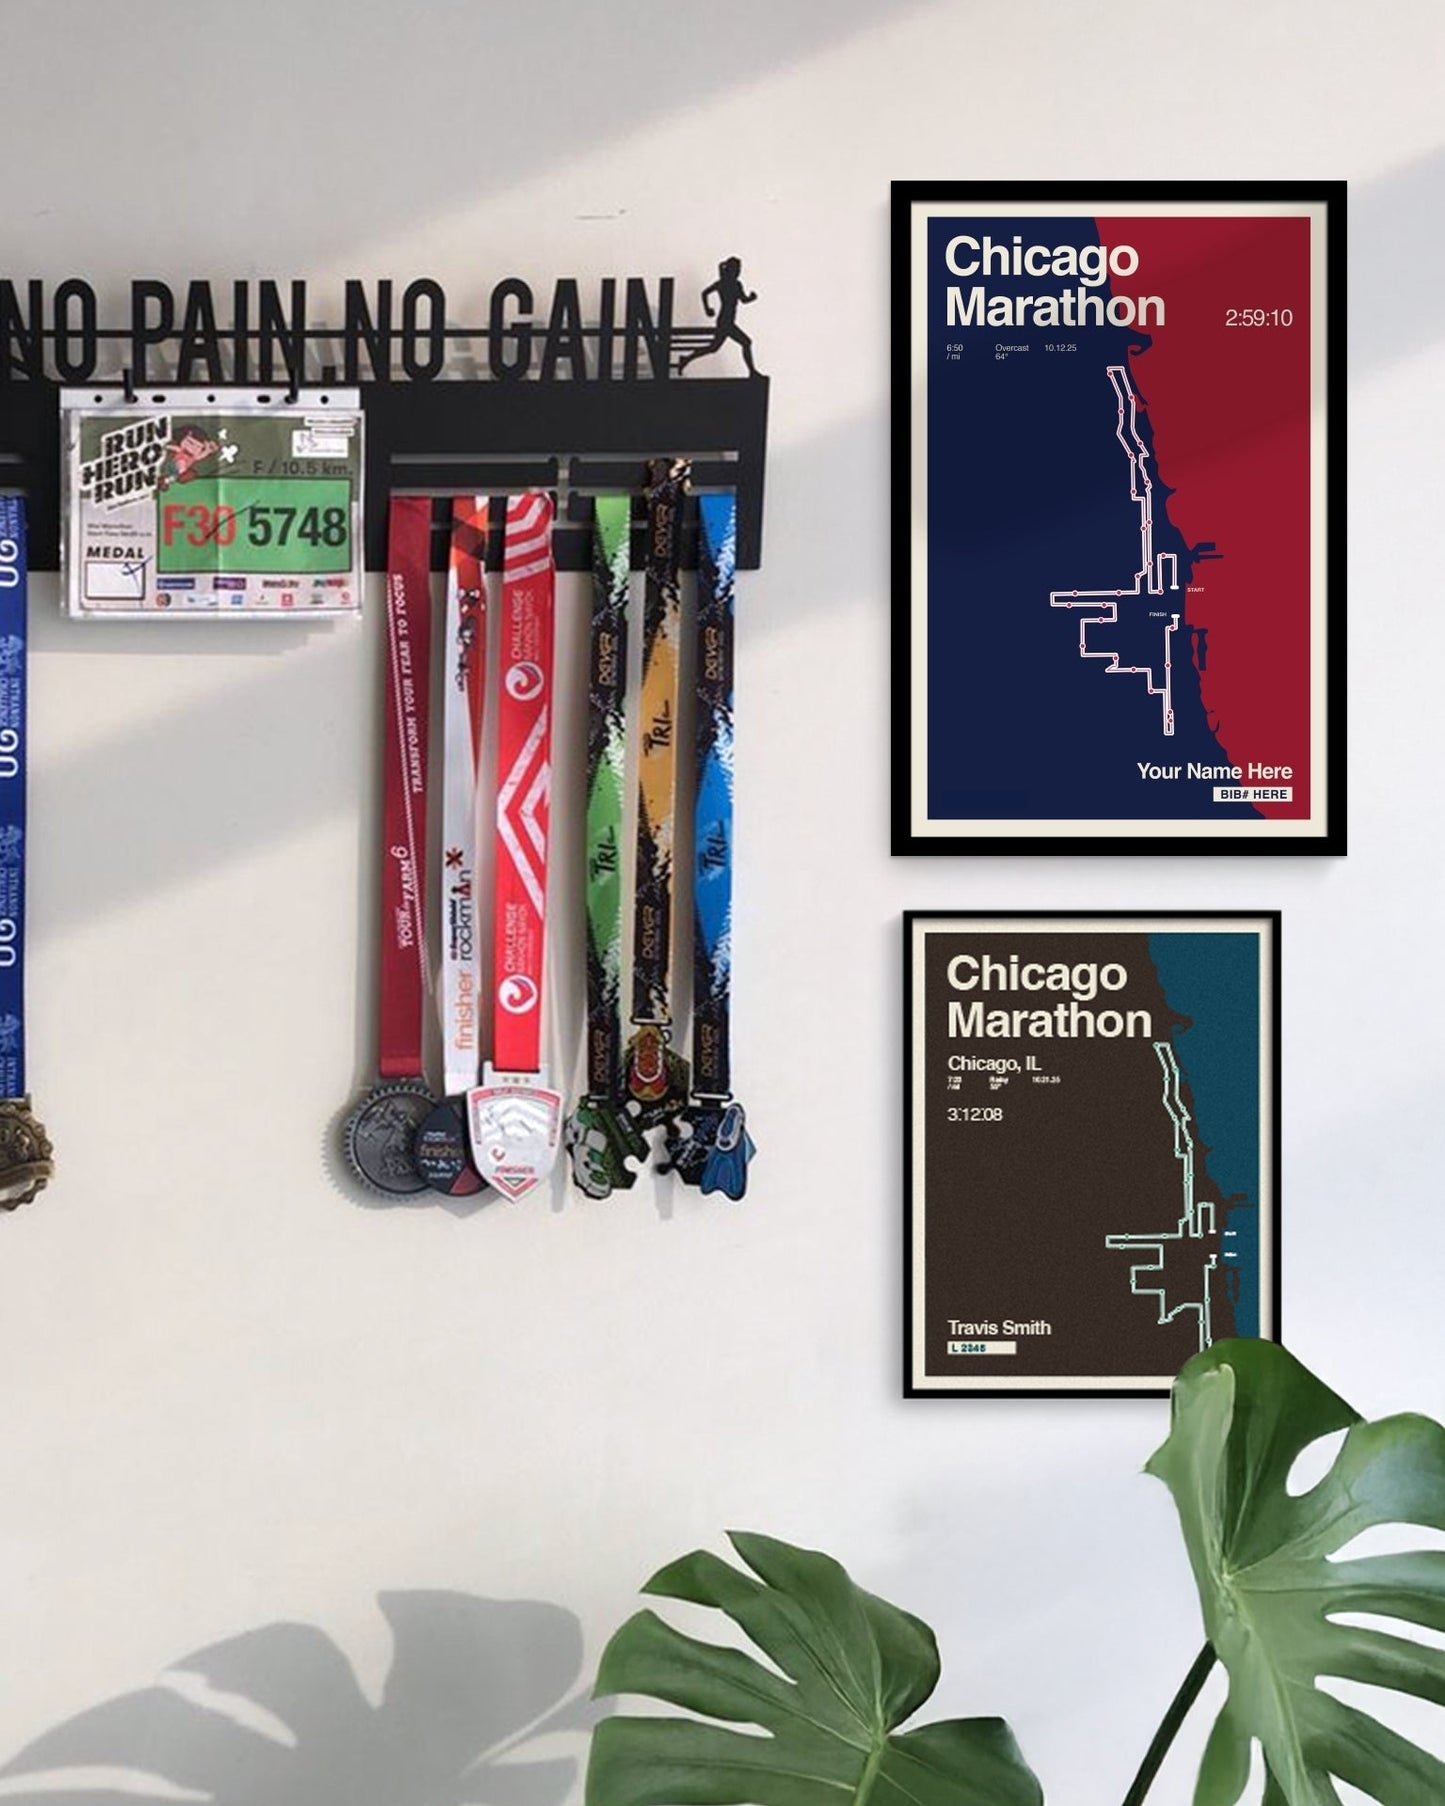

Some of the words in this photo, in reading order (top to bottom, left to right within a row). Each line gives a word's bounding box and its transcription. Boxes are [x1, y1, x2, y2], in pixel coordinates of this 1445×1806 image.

[945, 235, 1139, 287] Chicago
[946, 286, 1165, 326] Marathon
[1225, 309, 1293, 327] 2:59:10
[0, 279, 97, 382] NO
[490, 277, 675, 382] GAIN
[946, 343, 964, 352] 6:50
[995, 343, 1030, 352] Overcast
[1044, 343, 1077, 352] 10.12.25
[104, 416, 168, 457] RUN
[82, 442, 162, 485] HERO
[253, 461, 262, 474] F
[282, 461, 318, 475] 10.5
[322, 461, 353, 476] km.
[94, 465, 156, 504] RUN
[163, 504, 236, 547] F30
[248, 506, 347, 547] 5748
[86, 546, 144, 559] MEDAL
[393, 574, 407, 615] FOCUS
[397, 618, 409, 636] TO
[399, 640, 413, 675] FEAR
[403, 677, 415, 713] YOUR
[406, 716, 423, 794] TRANSFORM
[1136, 762, 1182, 780] Your
[1187, 762, 1243, 780] Name
[1248, 762, 1293, 780] Here
[1220, 789, 1249, 799] BIB#
[1253, 789, 1288, 799] HERE
[947, 954, 1128, 1001] Chicago
[454, 968, 473, 1050] finisher
[948, 1001, 1152, 1038] Marathon
[948, 1055, 1021, 1074] Chicago,
[1026, 1055, 1042, 1071] IL
[947, 1319, 998, 1335] Travis
[1002, 1319, 1052, 1335] Smith
